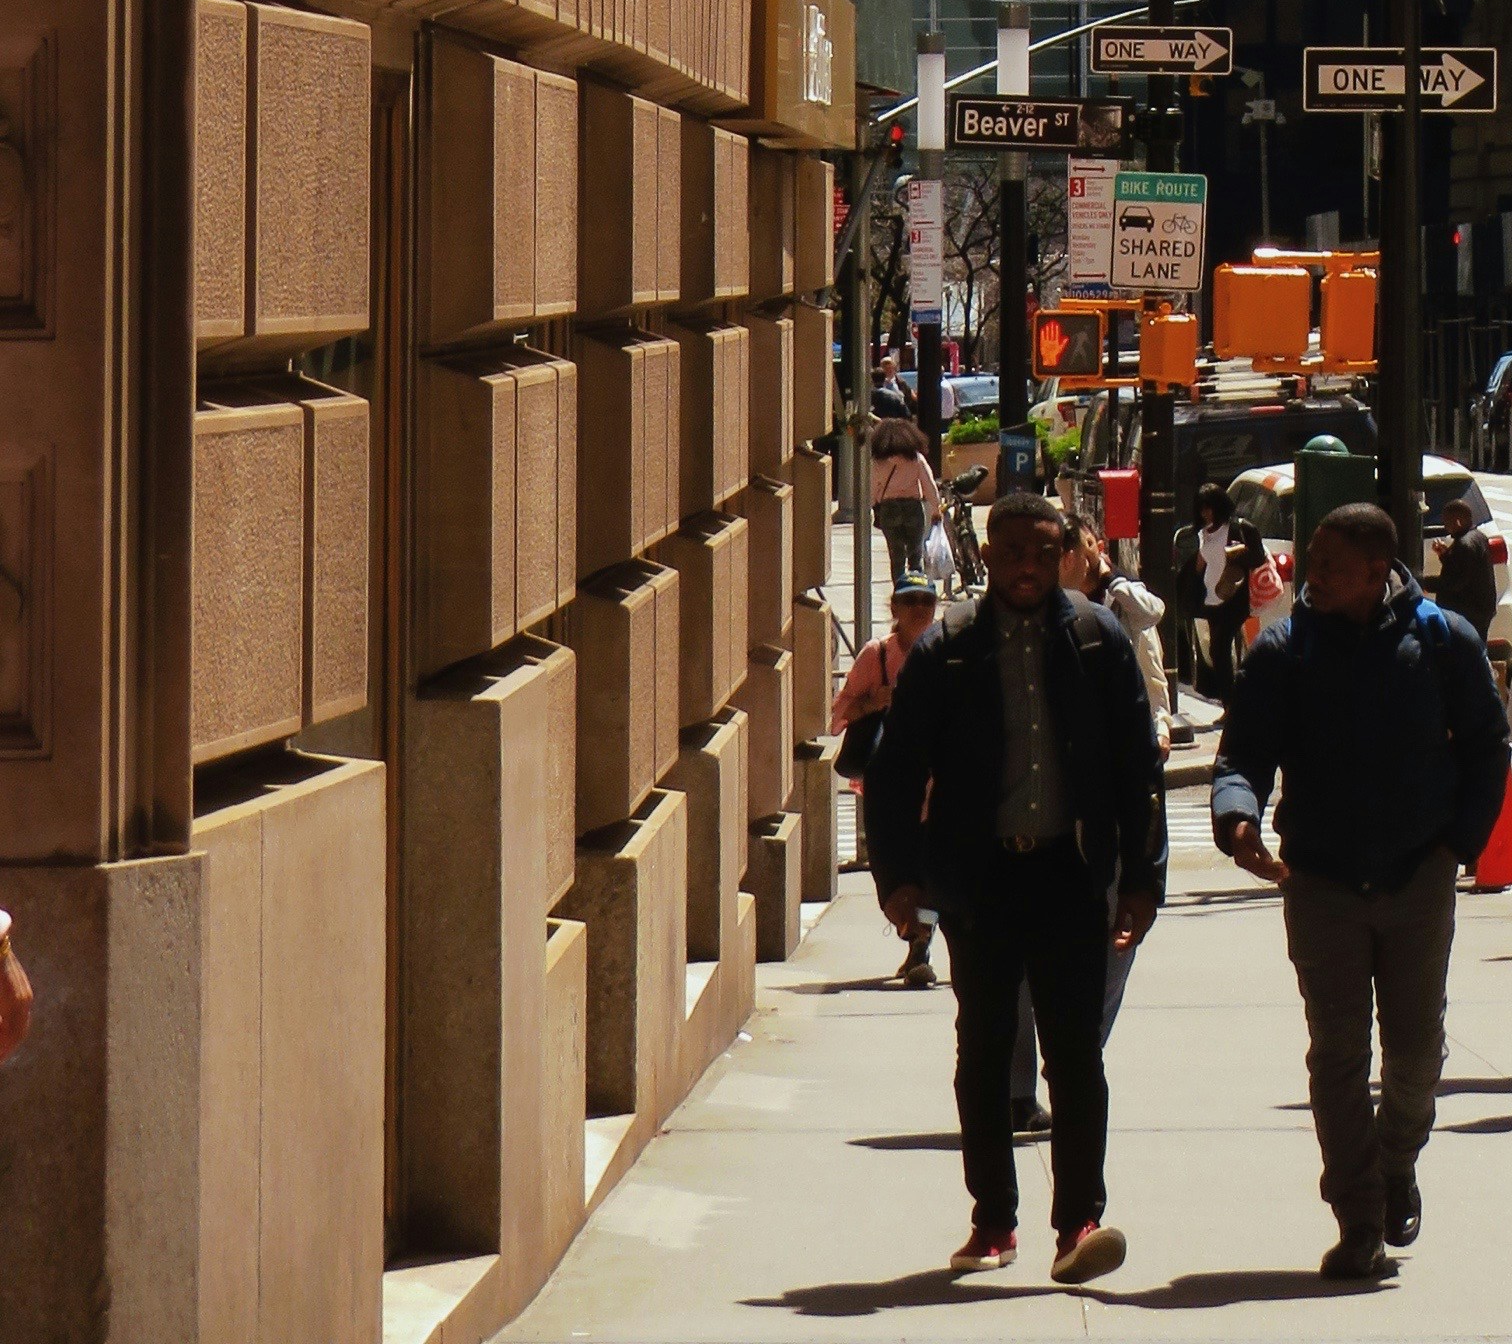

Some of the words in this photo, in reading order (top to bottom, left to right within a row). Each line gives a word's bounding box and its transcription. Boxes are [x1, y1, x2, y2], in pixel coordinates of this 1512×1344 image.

[1105, 42, 1145, 58] ONE
[1169, 42, 1212, 59] WAY
[1333, 69, 1386, 91] ONE
[1016, 104, 1035, 115] 2-12
[964, 109, 1048, 138] Beaver
[1055, 112, 1070, 127] ST
[1073, 179, 1083, 197] 3
[1121, 181, 1150, 195] BIKE
[1156, 181, 1198, 198] ROUTE
[1120, 238, 1196, 258] SHARED
[1131, 261, 1181, 280] LANE
[1016, 452, 1029, 472] P
